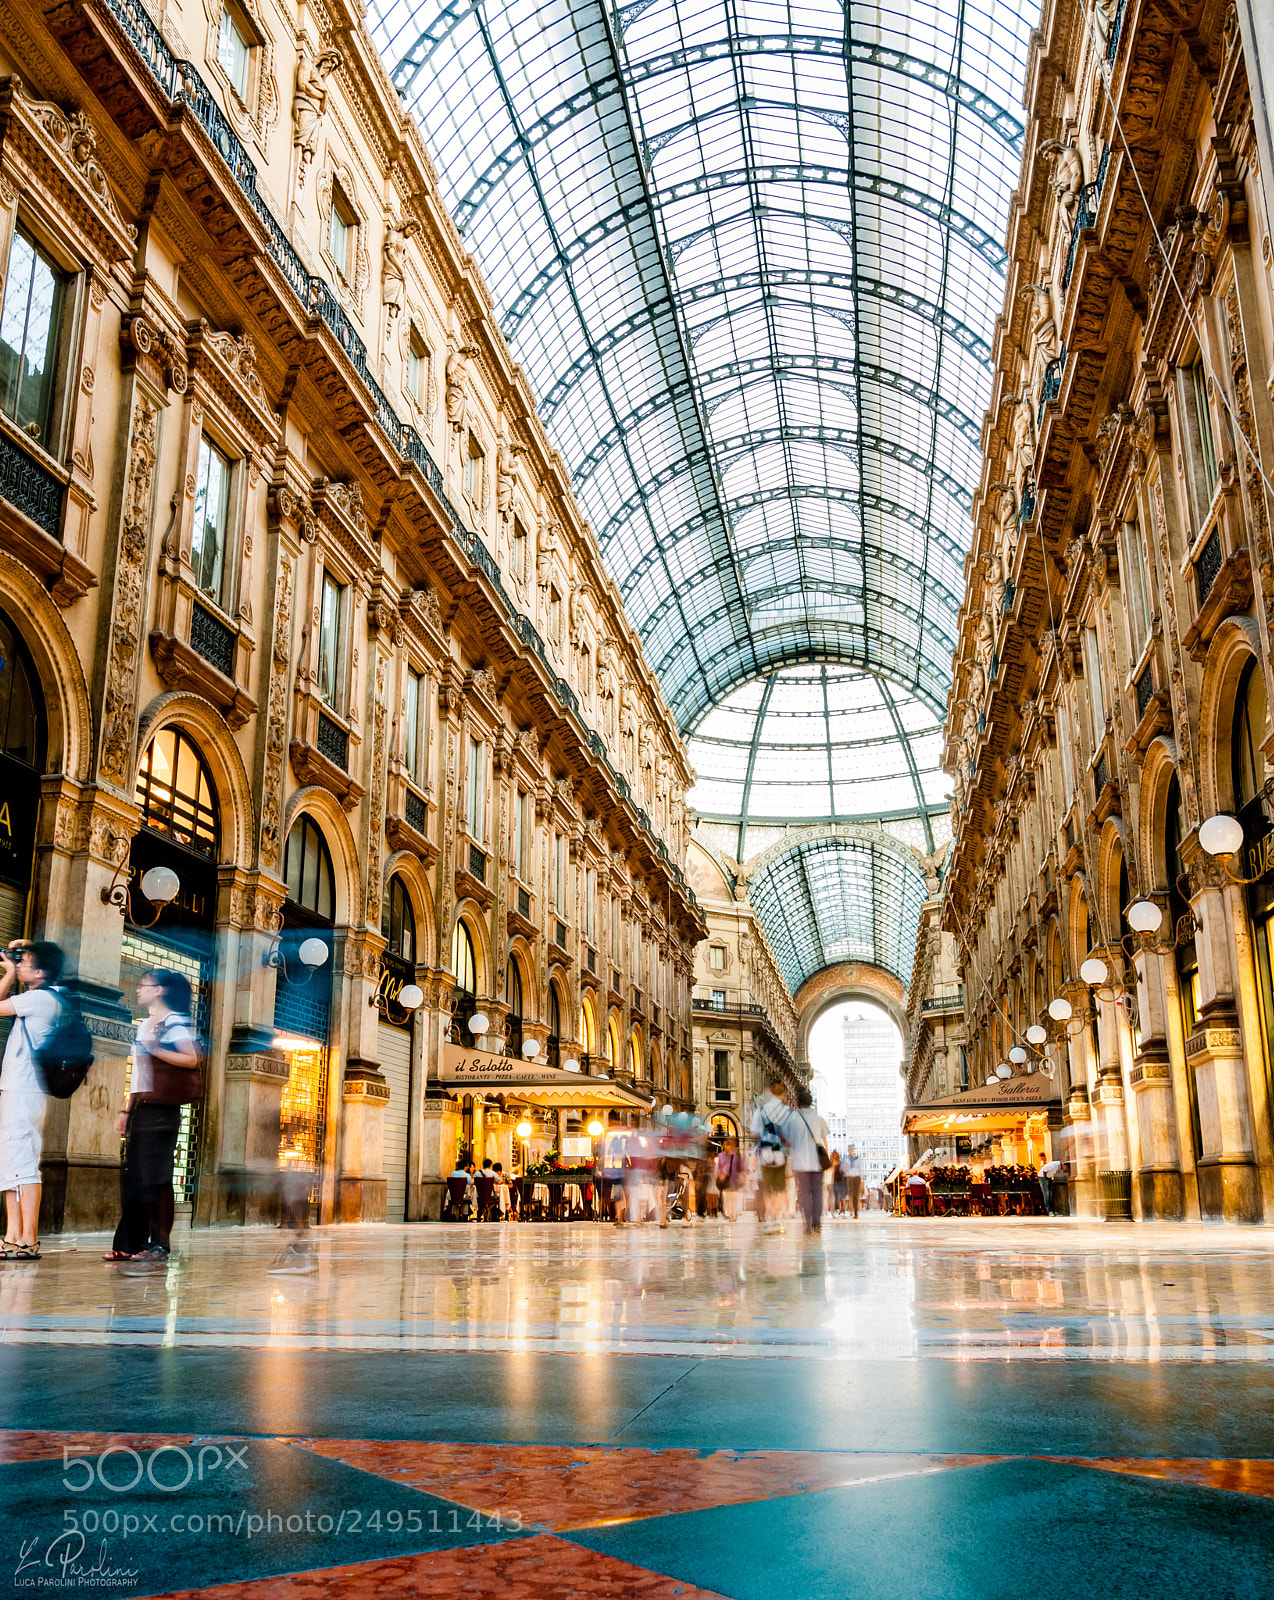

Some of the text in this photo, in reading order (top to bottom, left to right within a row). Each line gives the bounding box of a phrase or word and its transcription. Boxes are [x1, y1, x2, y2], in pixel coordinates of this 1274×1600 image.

[455, 1058, 513, 1072] il Salotto
[998, 1082, 1040, 1095] Galleria
